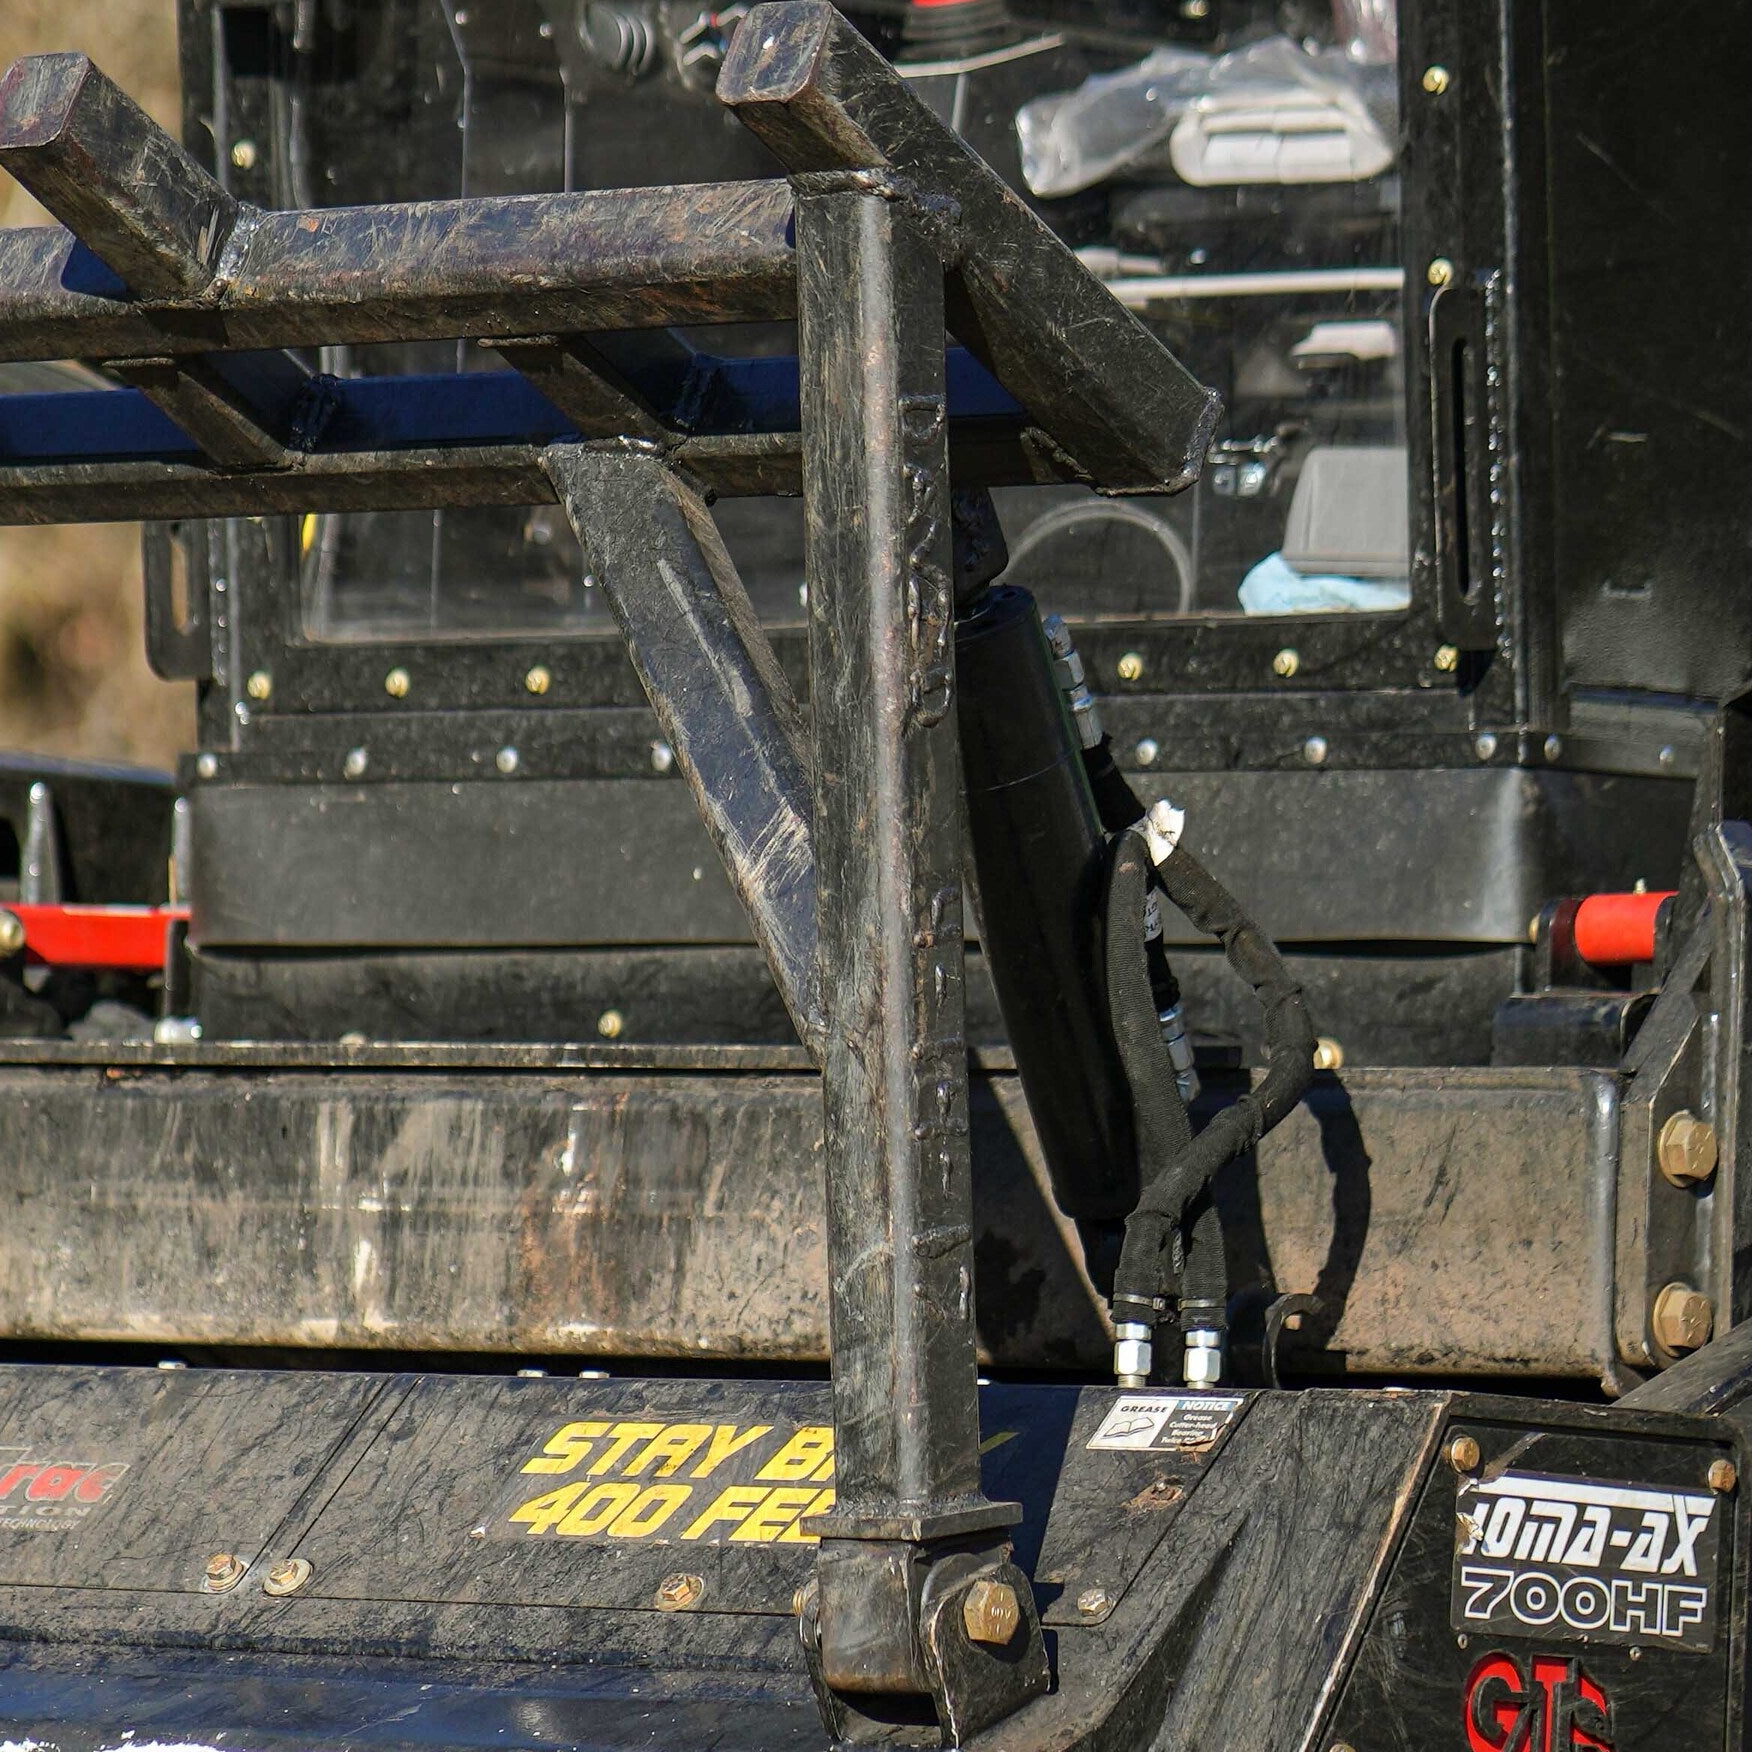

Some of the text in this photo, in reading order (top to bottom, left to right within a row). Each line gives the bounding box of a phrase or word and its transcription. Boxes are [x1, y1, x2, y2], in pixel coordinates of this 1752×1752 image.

[1120, 1405, 1168, 1413] GREASE
[1182, 1401, 1230, 1411] NOTICE
[520, 1422, 774, 1479] STAY
[508, 1481, 693, 1538] 400
[1460, 1566, 1708, 1637] 700HF
